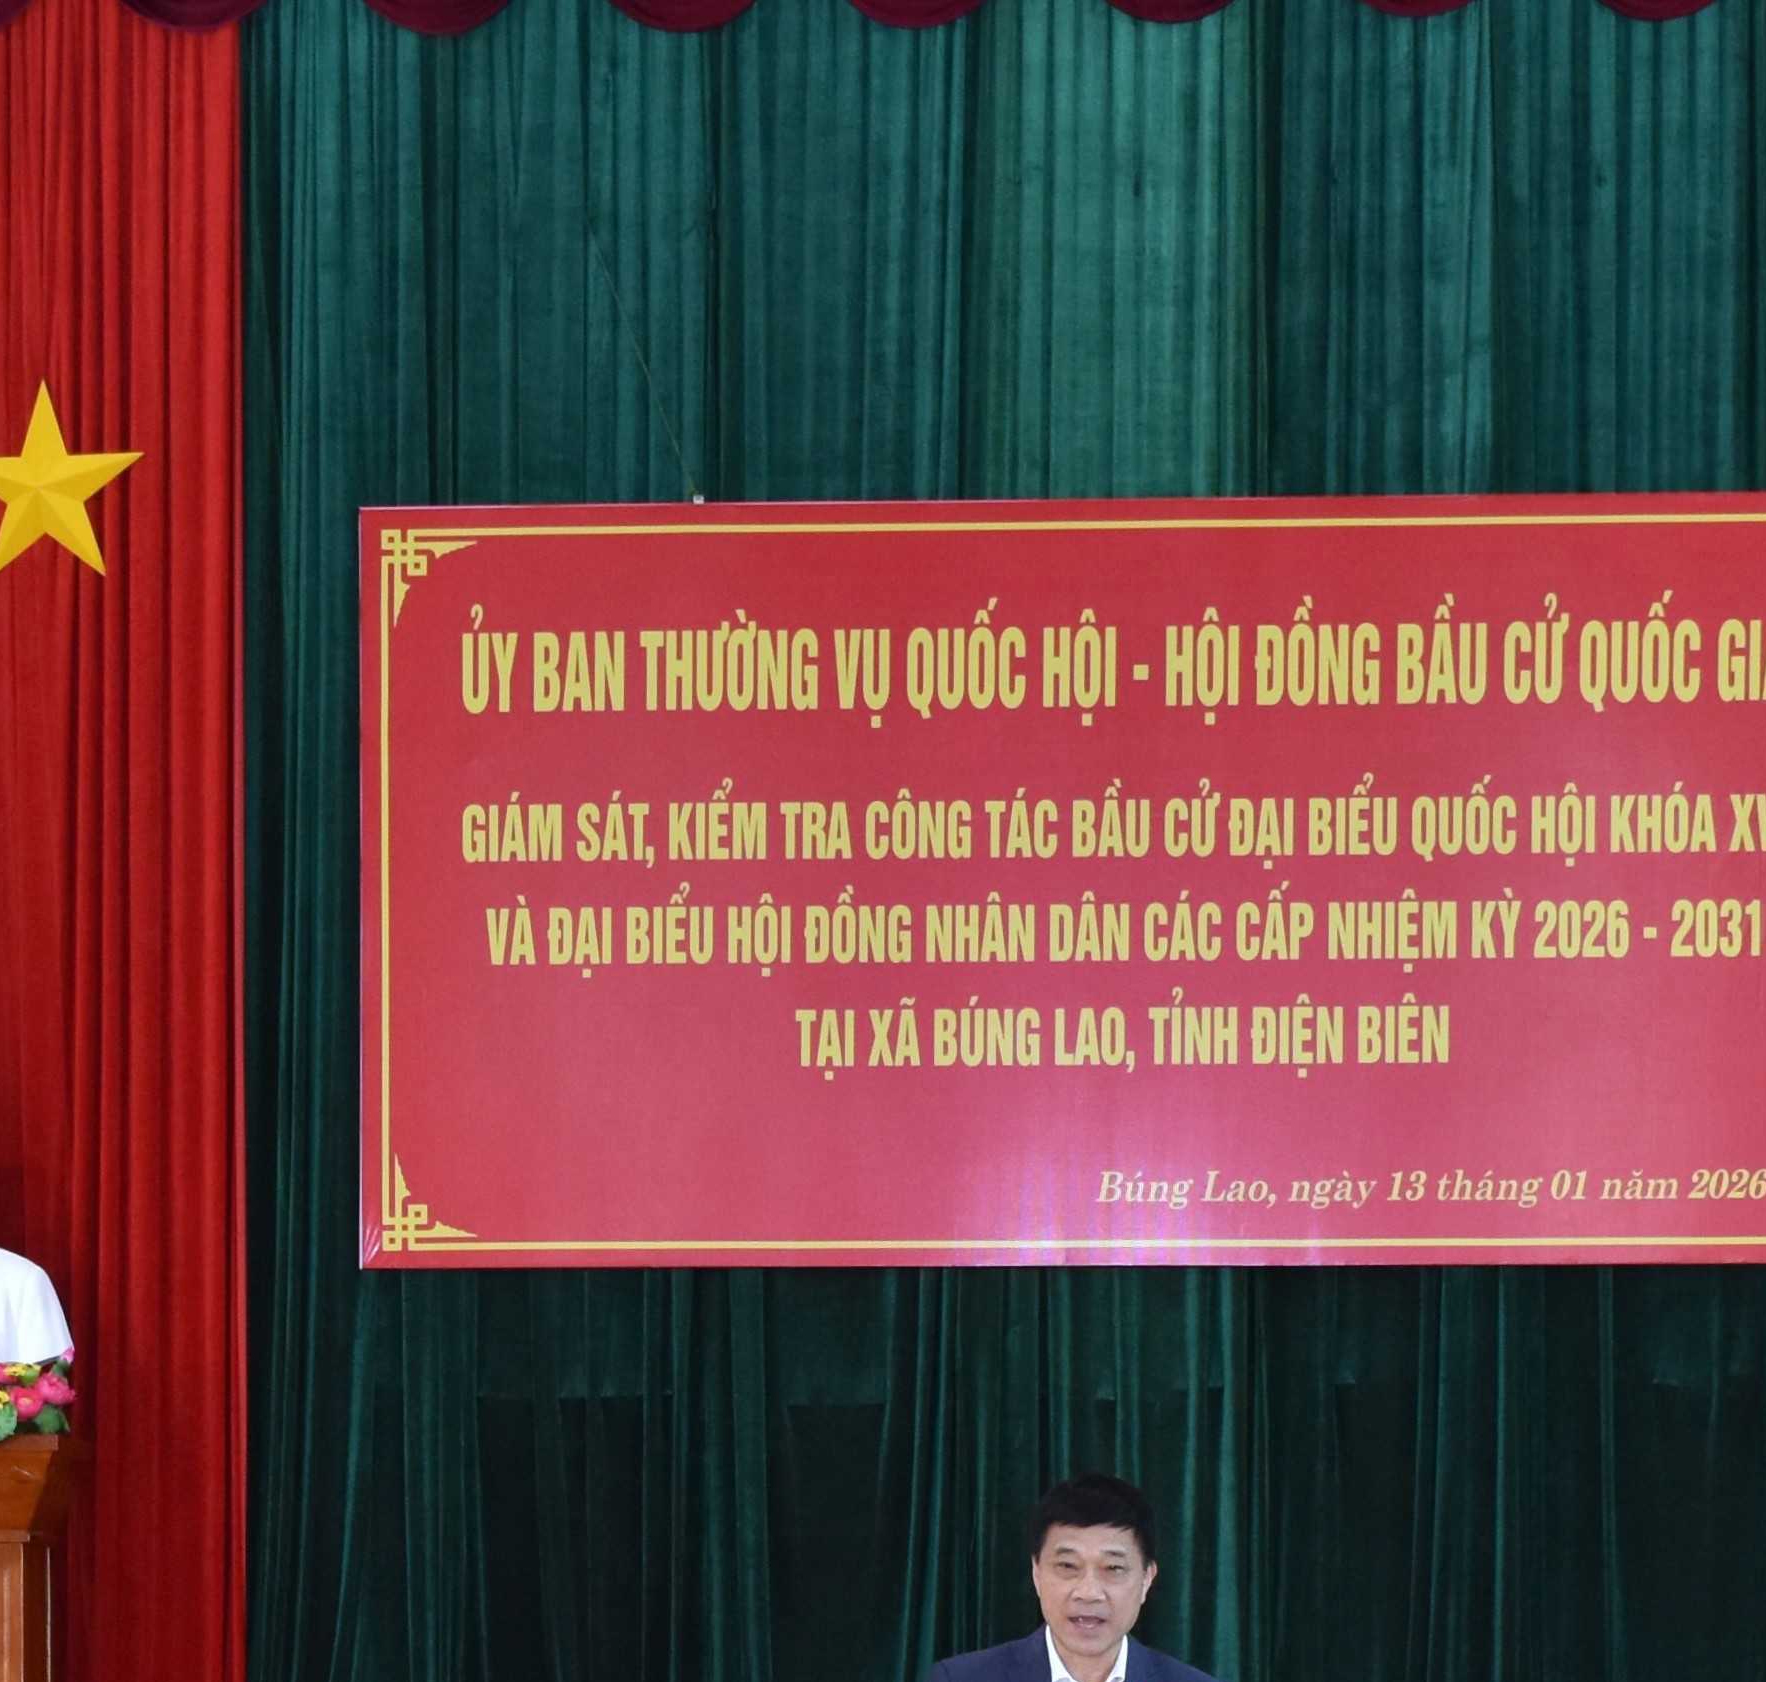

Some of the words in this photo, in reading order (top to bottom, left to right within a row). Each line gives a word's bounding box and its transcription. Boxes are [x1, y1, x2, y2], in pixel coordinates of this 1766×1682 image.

[462, 604, 518, 714] ỦY
[533, 631, 626, 713] BAN
[639, 608, 819, 712] THƯỜNG
[834, 628, 891, 729] VỤ
[906, 597, 1027, 719] QUỐC
[1042, 608, 1117, 727] HỘI
[1133, 664, 1150, 681] -
[1165, 606, 1240, 725] HỘI
[1254, 595, 1381, 707] ĐỒNG
[1396, 593, 1488, 705] BẦU
[1503, 592, 1570, 705] CỬ
[1579, 590, 1702, 713] QUỐC
[462, 791, 563, 863] GIÁM
[576, 790, 655, 868] SÁT,
[668, 777, 768, 860] KIỂM
[780, 801, 853, 860] TRA
[865, 788, 972, 860] CÔNG
[984, 787, 1059, 859] TÁC
[1072, 778, 1151, 858] BẦU
[1164, 778, 1221, 858] CỬ
[1228, 797, 1295, 870] ĐẠI
[1308, 772, 1398, 856] BIỂU
[1411, 774, 1518, 862] QUỐC
[1530, 782, 1597, 868] HỘI
[1609, 781, 1717, 854] KHÓA
[486, 895, 536, 966] VÀ
[547, 906, 613, 978] ĐẠI
[626, 881, 714, 965] BIỂU
[727, 892, 792, 977] HỘI
[803, 885, 912, 964] ĐỒNG
[925, 891, 1036, 963] NHÂN
[1049, 890, 1130, 962] DÂN
[1143, 889, 1223, 962] CÁC
[1235, 880, 1315, 961] CẤP
[1327, 888, 1458, 973] NHIỆM
[1471, 887, 1522, 959] KỲ
[1533, 899, 1631, 959] 2026
[1642, 925, 1658, 939] -
[1670, 898, 1762, 958] 2031
[795, 1008, 855, 1081] TẠI
[868, 997, 921, 1067] XÃ
[933, 995, 1042, 1067] BÚNG
[1054, 1006, 1136, 1073] LAO,
[1148, 986, 1239, 1065] TỈNH
[1250, 993, 1344, 1078] ĐIỆN
[1357, 992, 1450, 1064] BIÊN
[1096, 1169, 1193, 1210] Búng
[1199, 1170, 1278, 1210] Lao,
[1289, 1170, 1375, 1210] ngày
[1388, 1170, 1428, 1201] 13
[1437, 1168, 1543, 1208] tháng
[1550, 1169, 1588, 1201] 01
[1601, 1171, 1679, 1201] năm
